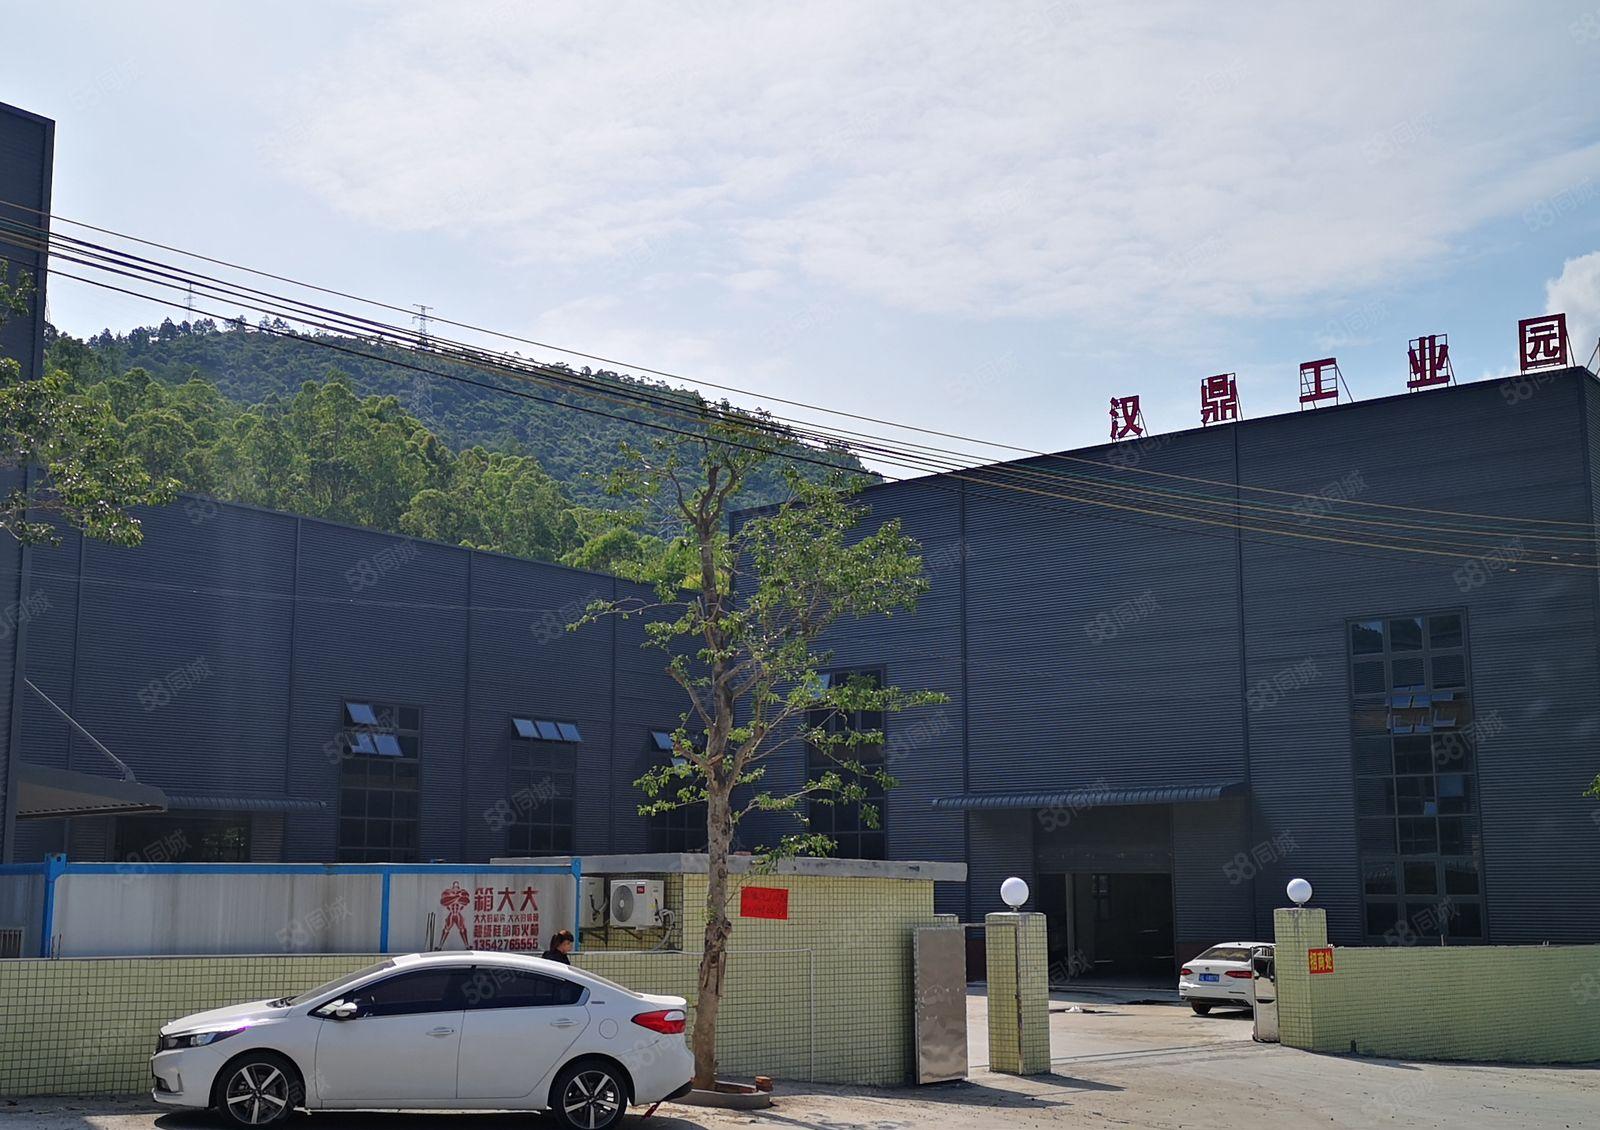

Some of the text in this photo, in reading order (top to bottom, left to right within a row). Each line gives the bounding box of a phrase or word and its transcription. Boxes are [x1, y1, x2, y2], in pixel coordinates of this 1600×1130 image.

[1110, 313, 1567, 439] 汉鼎工业园
